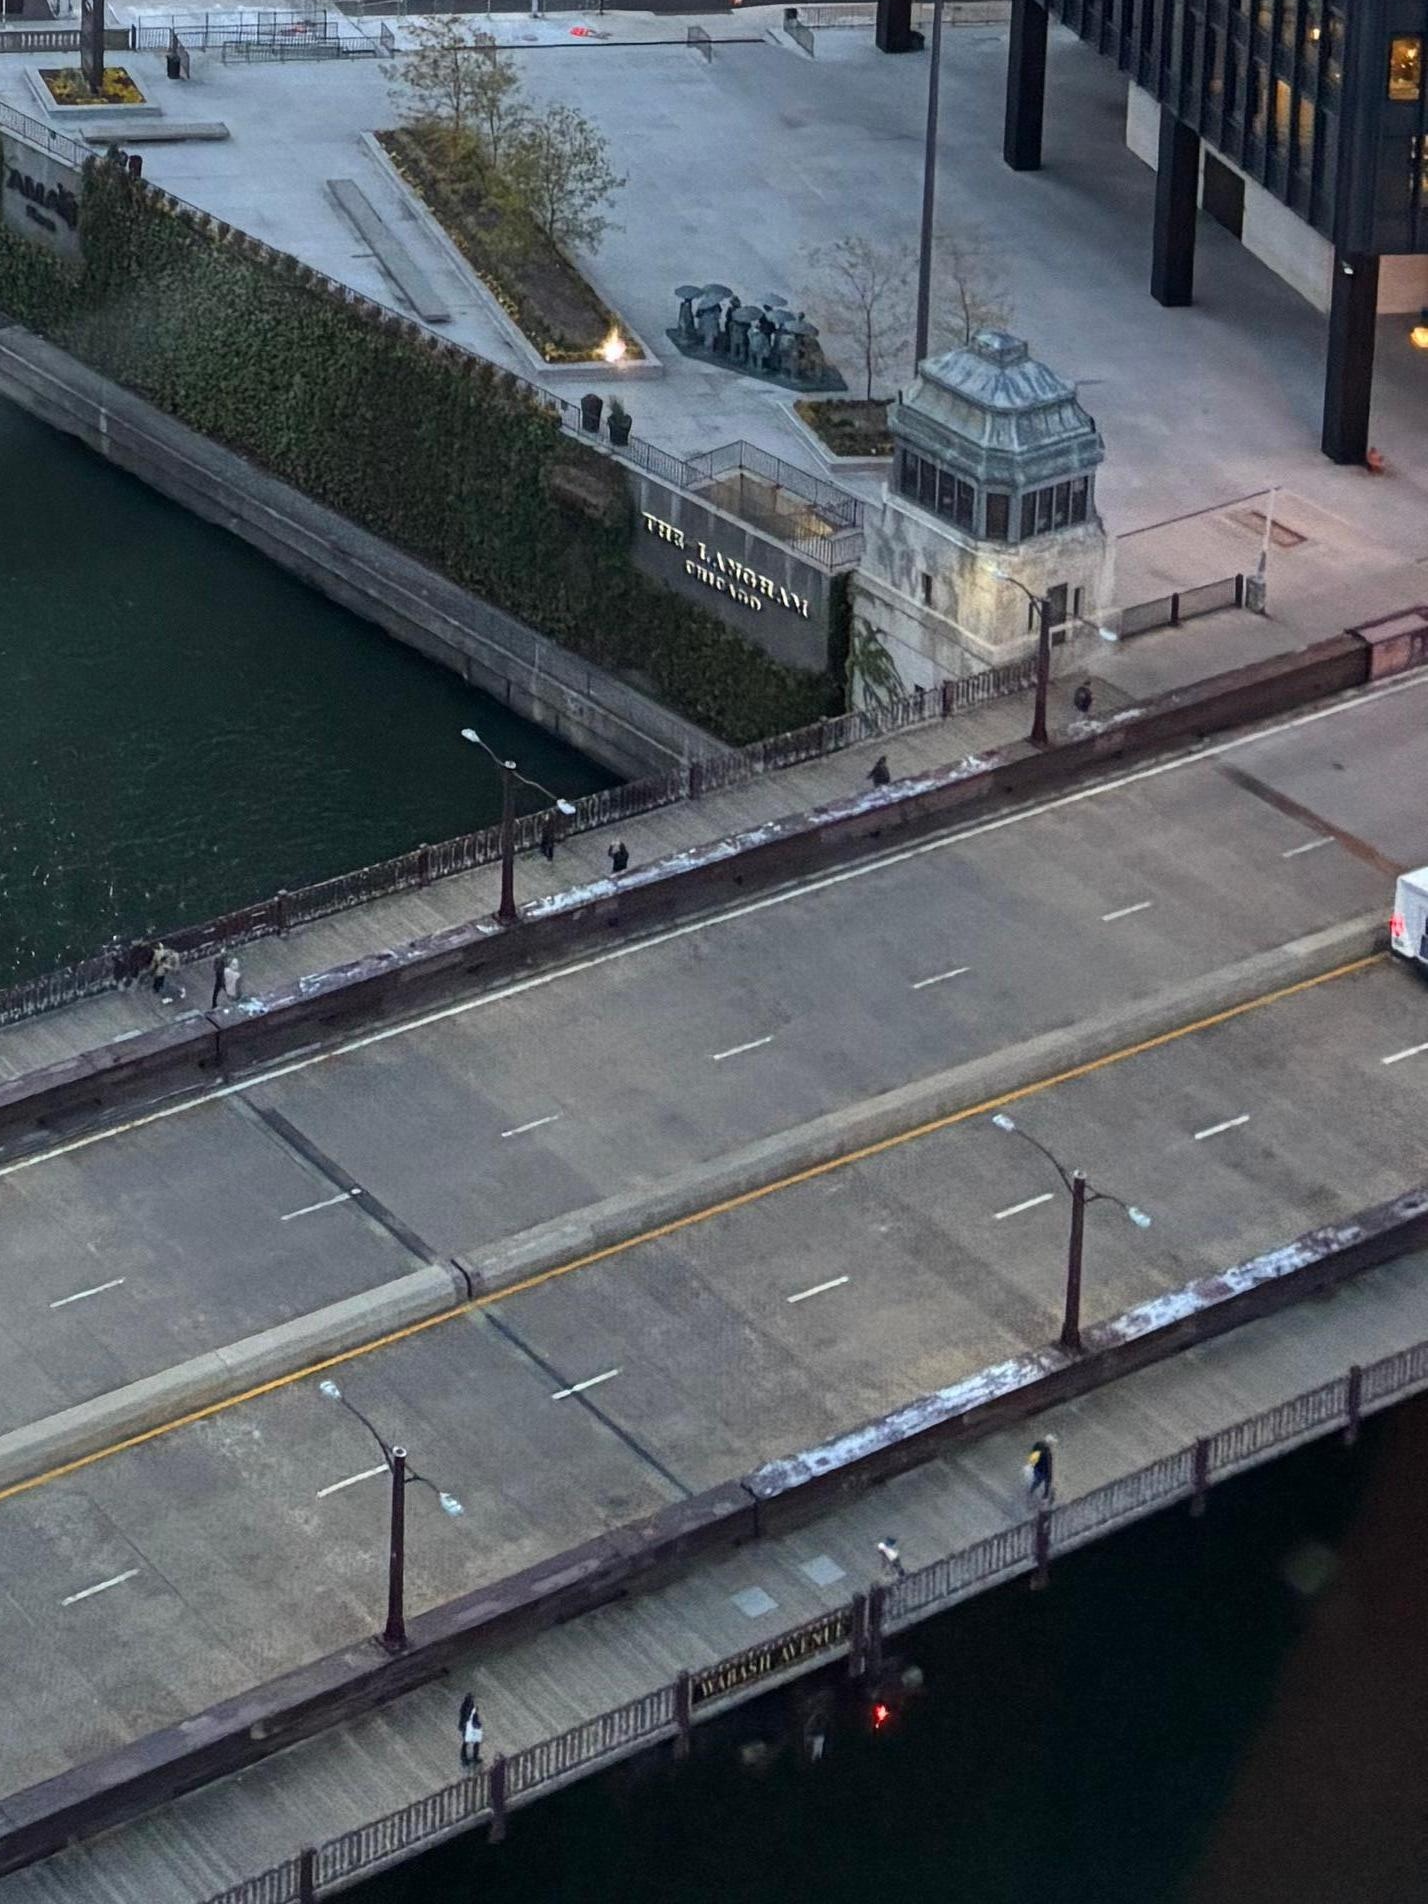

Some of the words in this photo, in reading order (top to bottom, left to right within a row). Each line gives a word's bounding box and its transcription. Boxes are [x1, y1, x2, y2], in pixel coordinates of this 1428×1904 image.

[642, 511, 685, 550] THE
[697, 541, 810, 619] LANGHAM
[685, 559, 762, 611] CHICAGO
[700, 1650, 772, 1697] WABASH
[781, 1618, 847, 1663] AVENUE
